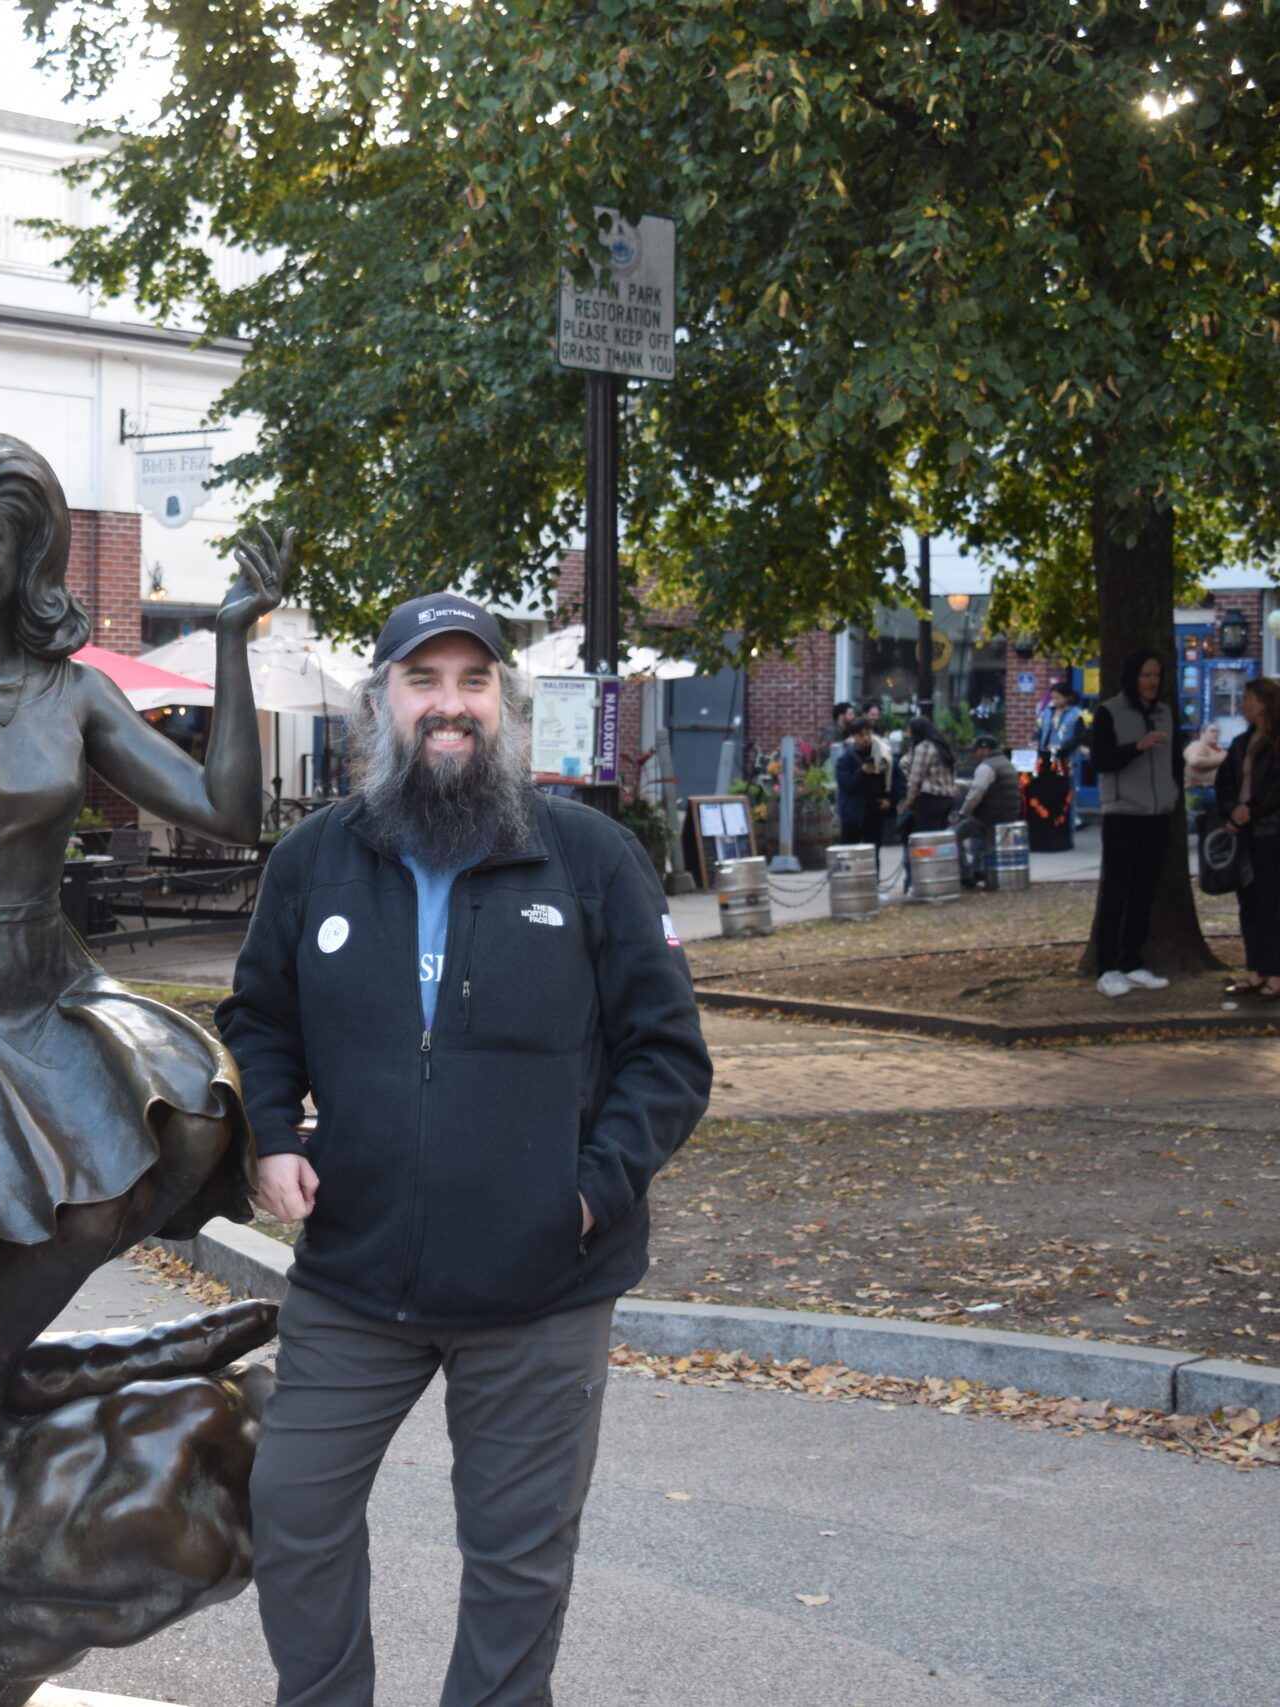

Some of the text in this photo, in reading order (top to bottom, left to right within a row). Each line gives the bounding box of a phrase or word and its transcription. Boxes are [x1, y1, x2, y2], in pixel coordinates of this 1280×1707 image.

[628, 283, 662, 306] PARK
[575, 298, 661, 328] RESTORATION
[564, 320, 670, 350] PLEASE KEEP OFF
[562, 342, 672, 374] GRASS THANK YOU
[602, 693, 616, 771] NALOXONE
